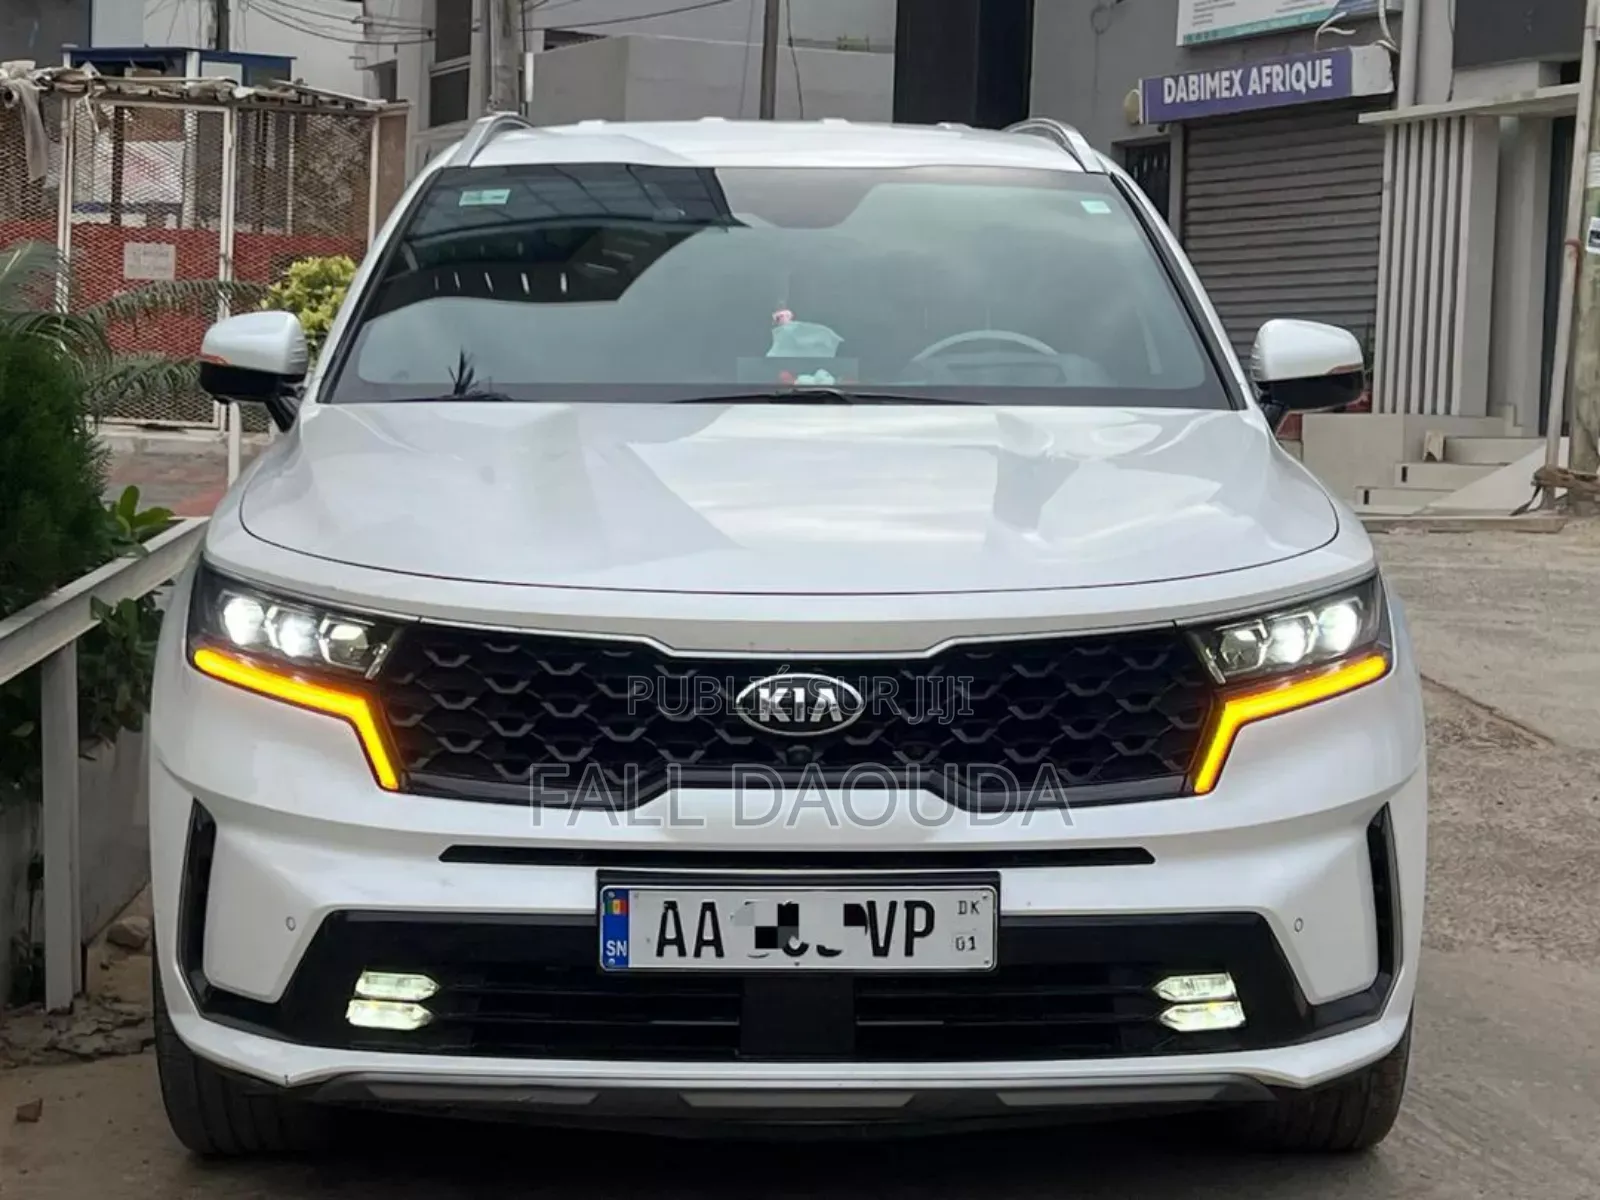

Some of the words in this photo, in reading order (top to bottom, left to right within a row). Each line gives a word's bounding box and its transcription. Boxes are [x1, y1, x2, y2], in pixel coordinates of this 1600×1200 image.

[1163, 68, 1244, 104] DABIMEX
[1247, 58, 1333, 96] AFRIQUE
[758, 687, 843, 723] KIA
[957, 900, 980, 915] DK
[656, 900, 725, 958] AA
[866, 900, 936, 958] VP
[605, 940, 628, 957] SN
